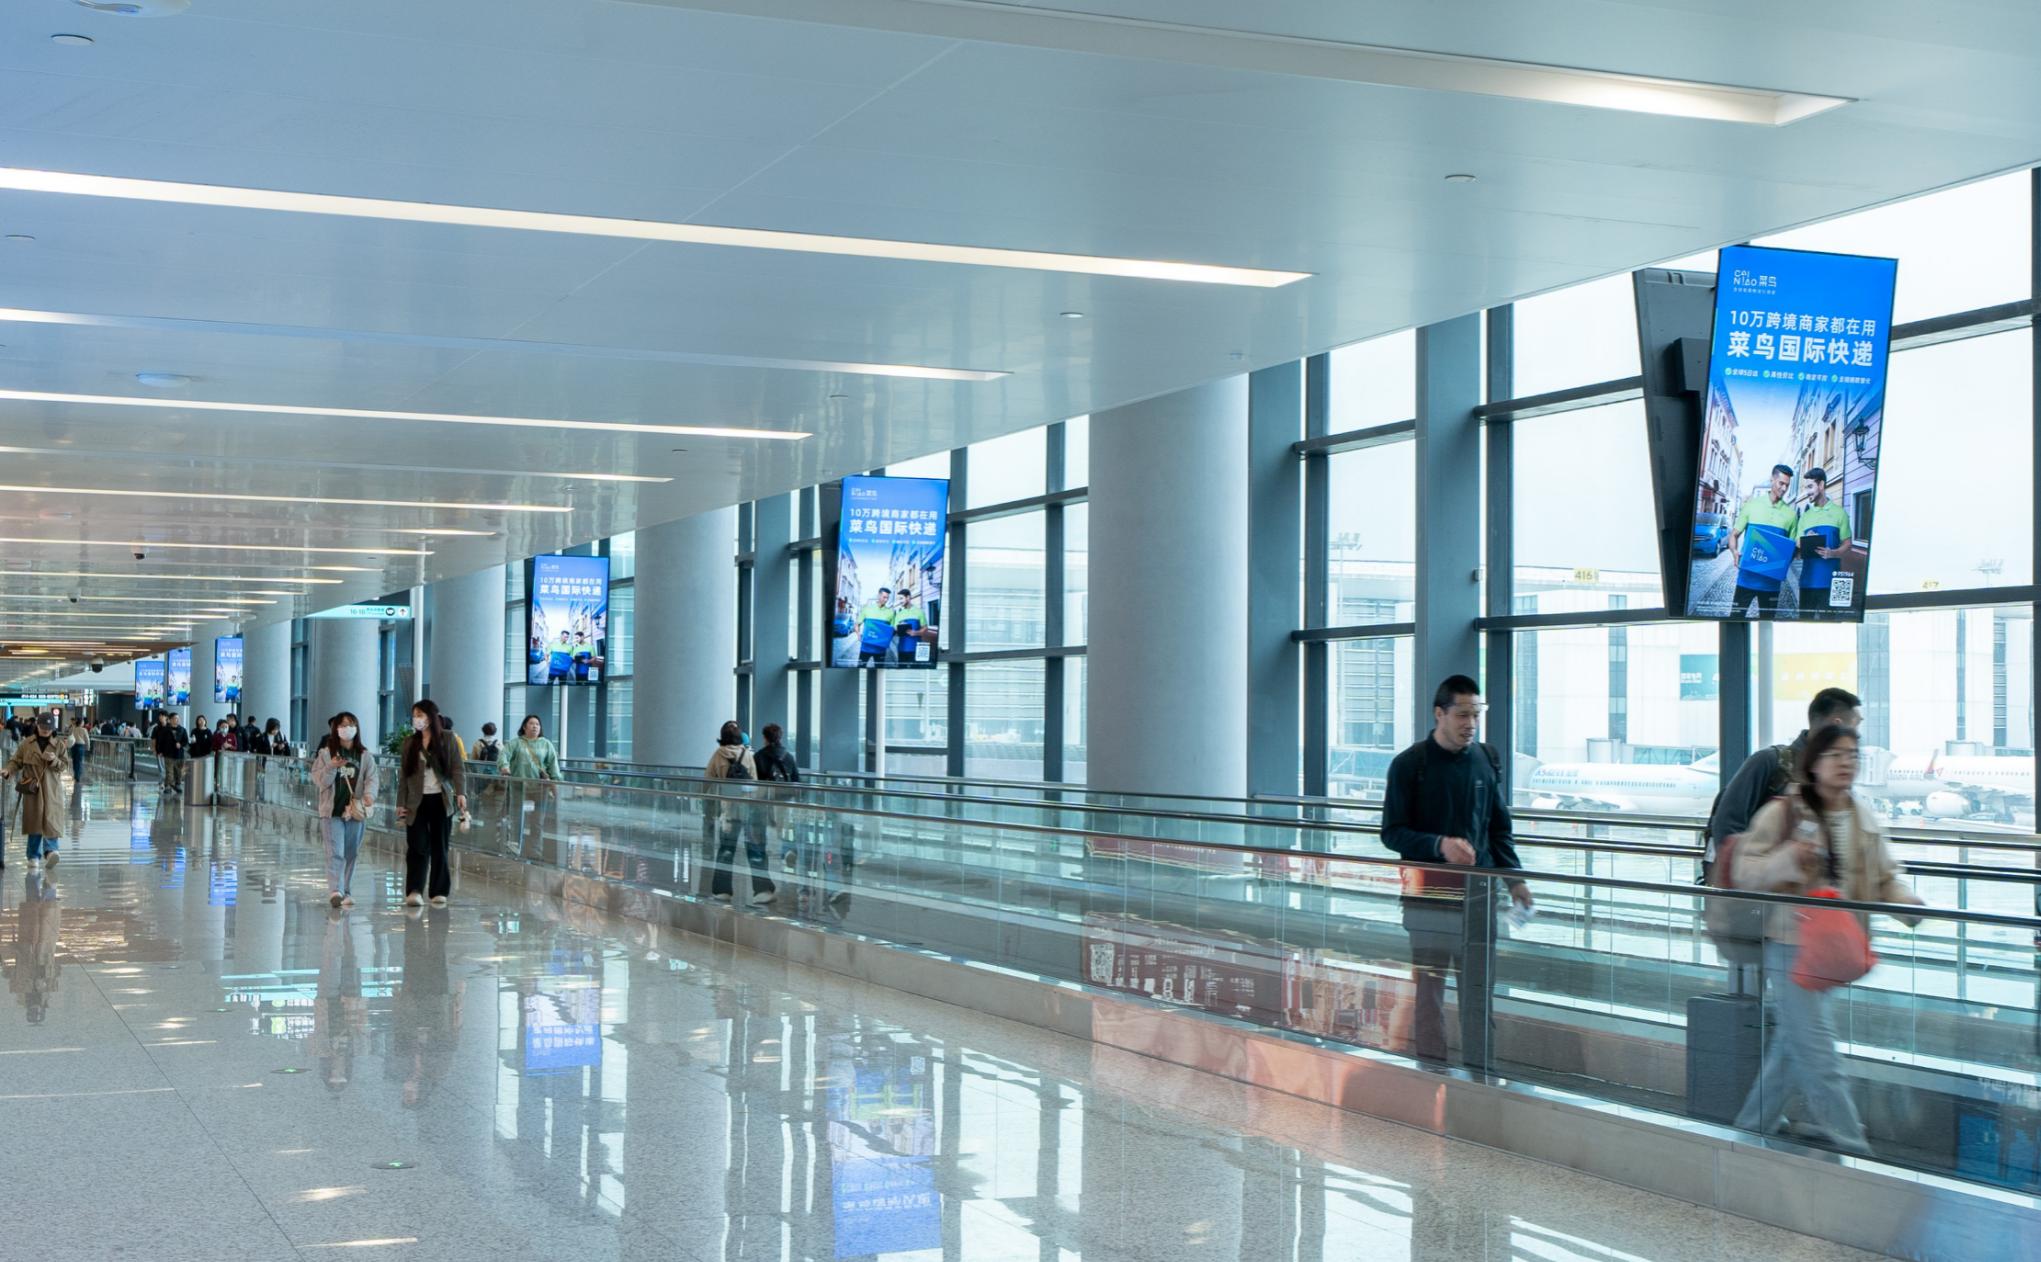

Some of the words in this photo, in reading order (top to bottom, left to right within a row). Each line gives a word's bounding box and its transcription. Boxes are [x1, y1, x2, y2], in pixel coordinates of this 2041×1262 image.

[1730, 310, 1877, 337] 10万跨境商家都在用
[1727, 330, 1873, 367] 菜鸟国际快递
[849, 519, 937, 536] 菜鸟国际快递
